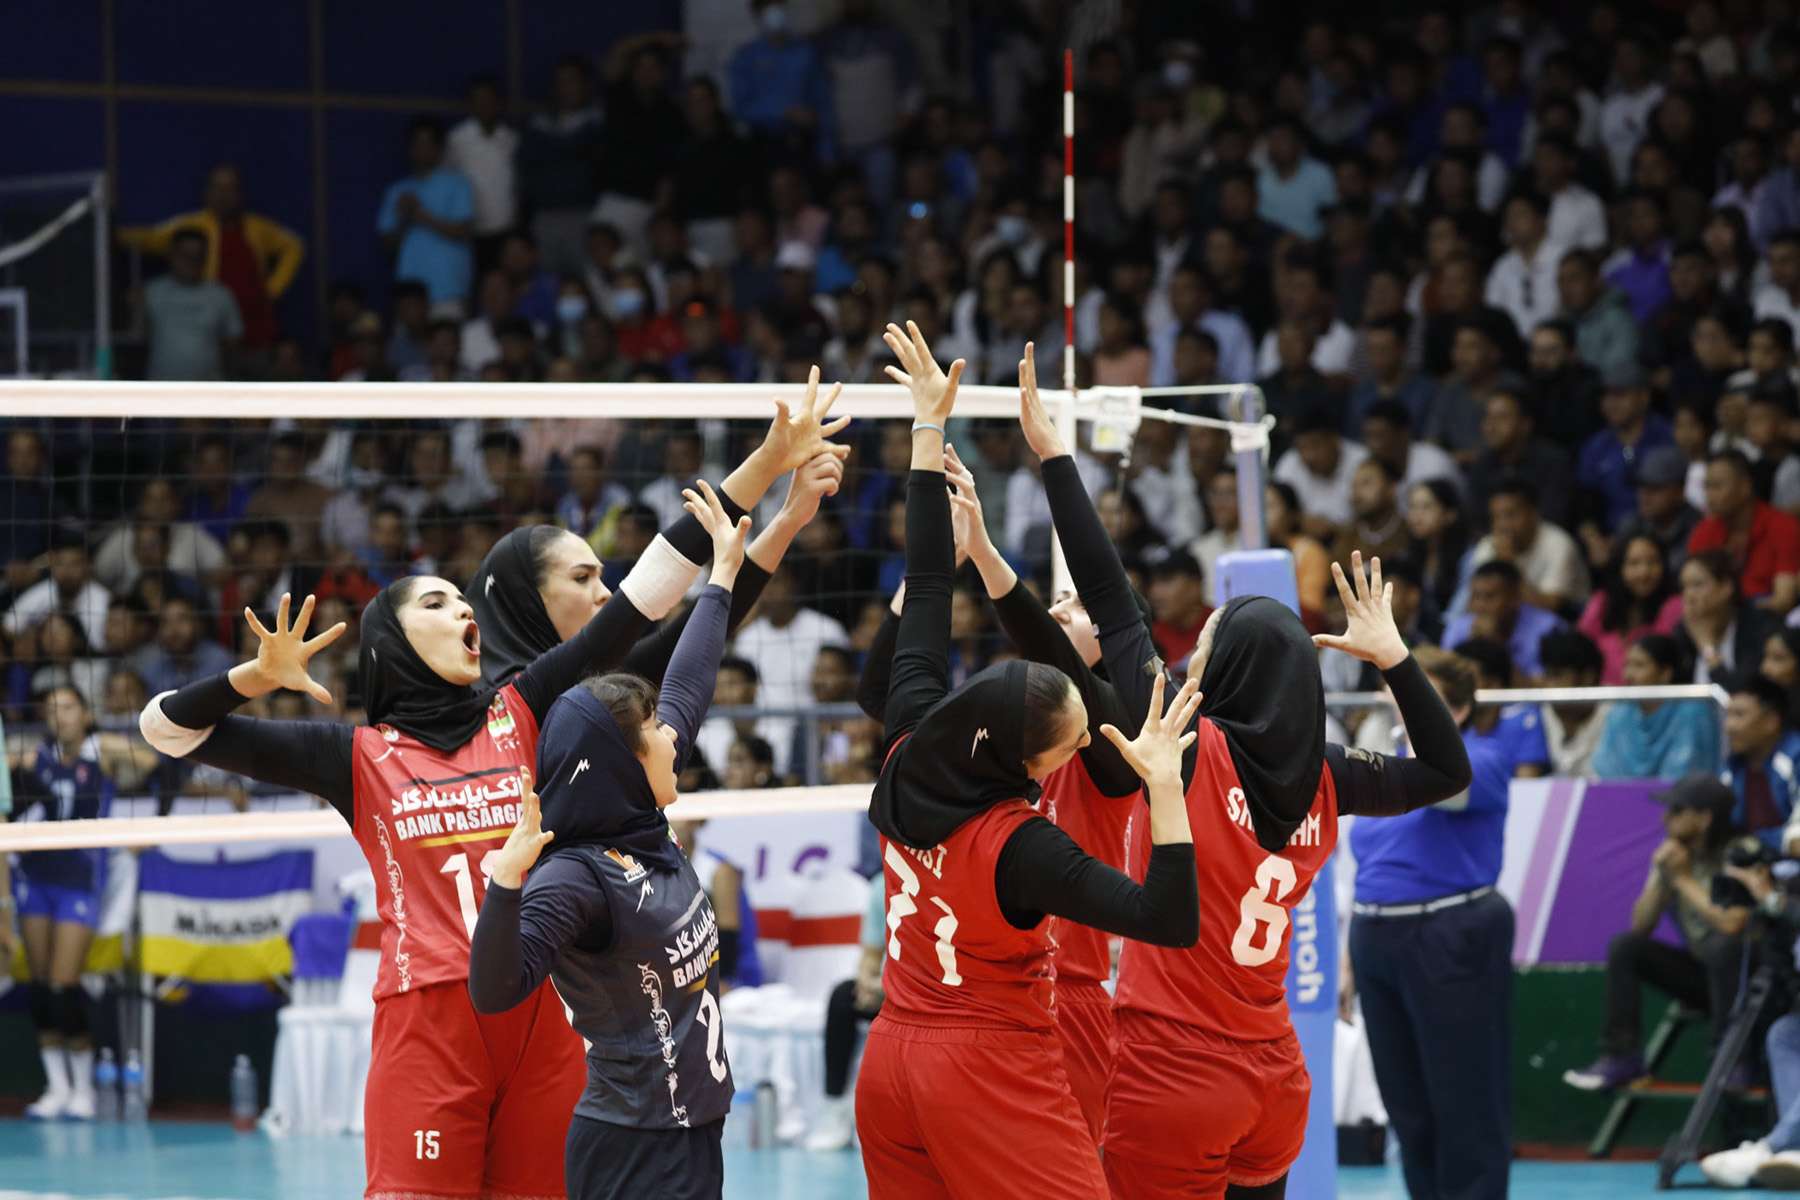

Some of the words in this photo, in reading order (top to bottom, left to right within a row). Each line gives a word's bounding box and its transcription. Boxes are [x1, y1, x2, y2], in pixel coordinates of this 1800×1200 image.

[394, 812, 444, 841] BANK
[443, 803, 523, 832] PASARGA
[1231, 854, 1297, 967] 6
[413, 1129, 441, 1160] 15
